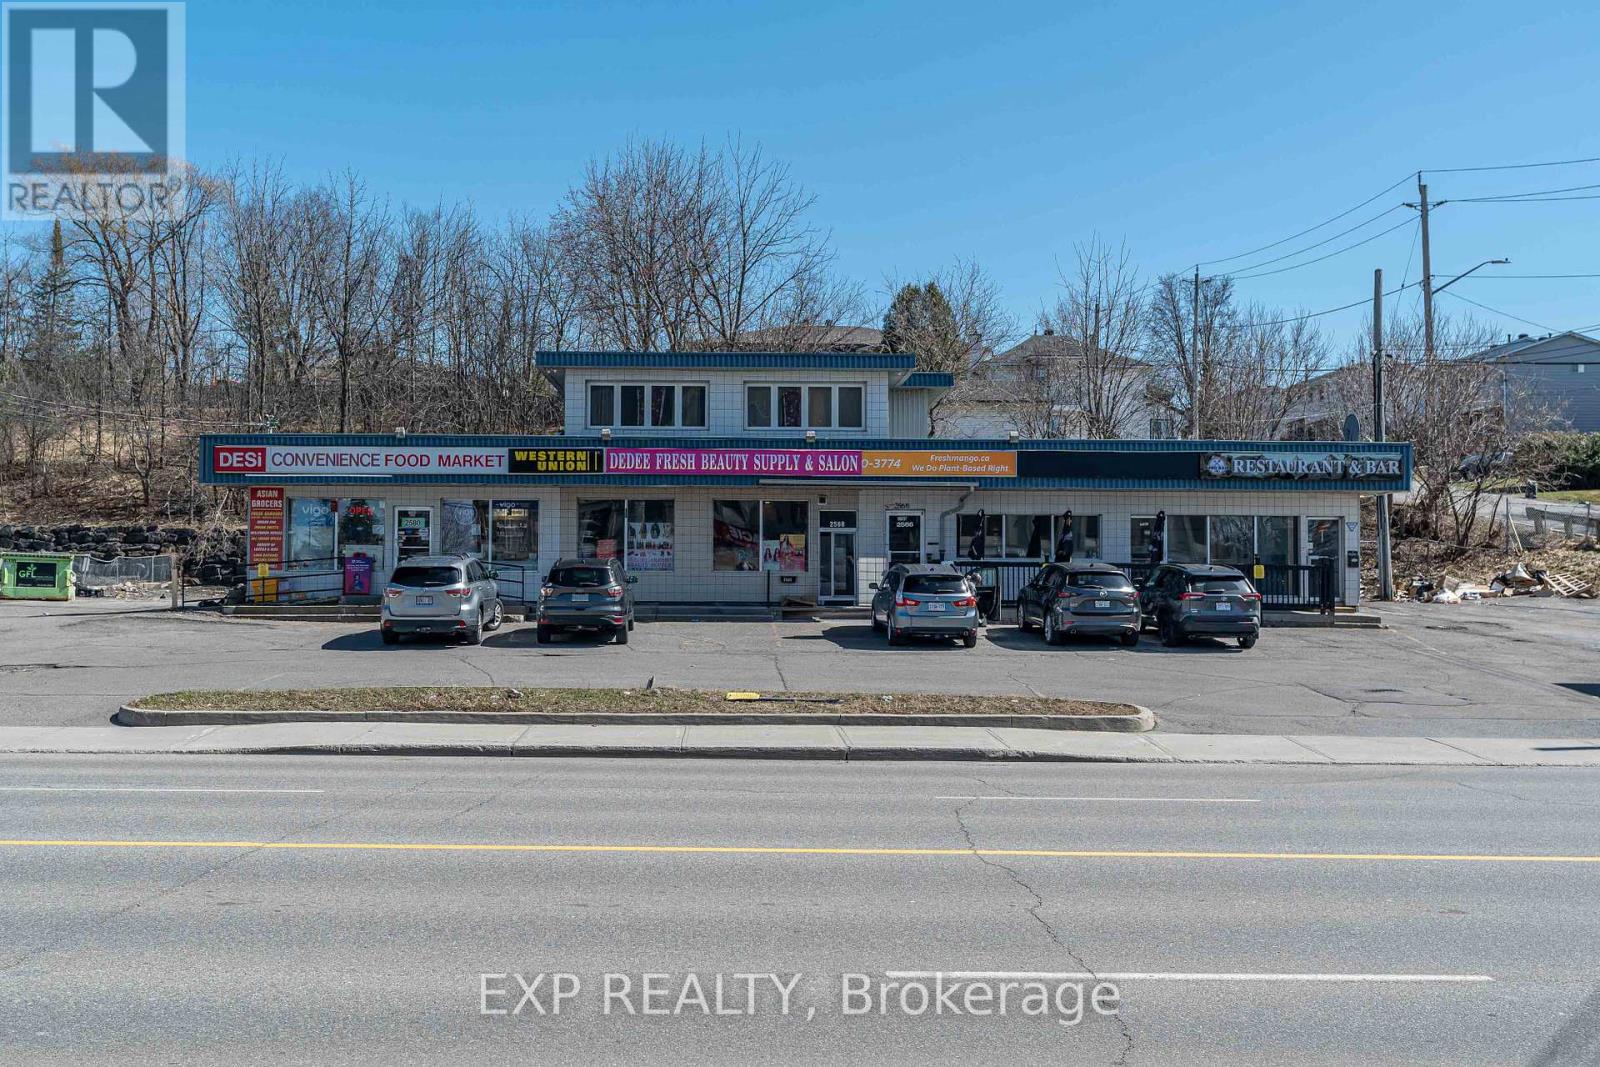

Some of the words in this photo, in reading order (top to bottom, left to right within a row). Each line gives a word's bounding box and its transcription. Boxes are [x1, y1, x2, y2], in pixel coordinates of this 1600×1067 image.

[271, 452, 381, 467] CONVENIENCE
[384, 453, 431, 467] FOOD
[438, 454, 505, 468] MARKET
[514, 451, 587, 461] WESTERN
[537, 461, 588, 471] UNION
[609, 452, 651, 470] DEDEE
[655, 453, 696, 470] FRESH
[701, 453, 749, 471] BEAUTY
[753, 454, 800, 471] SUPPLY
[804, 454, 814, 471] &
[818, 454, 859, 472] SALON
[1233, 459, 1346, 474] RESTAURANT
[1349, 460, 1362, 474] &
[1366, 461, 1400, 474] BAR
[939, 465, 986, 473] Plant-Based
[988, 465, 1009, 474] Right
[256, 489, 279, 498] ASIAN
[251, 499, 283, 508] GROCERS
[18, 569, 37, 578] GFL
